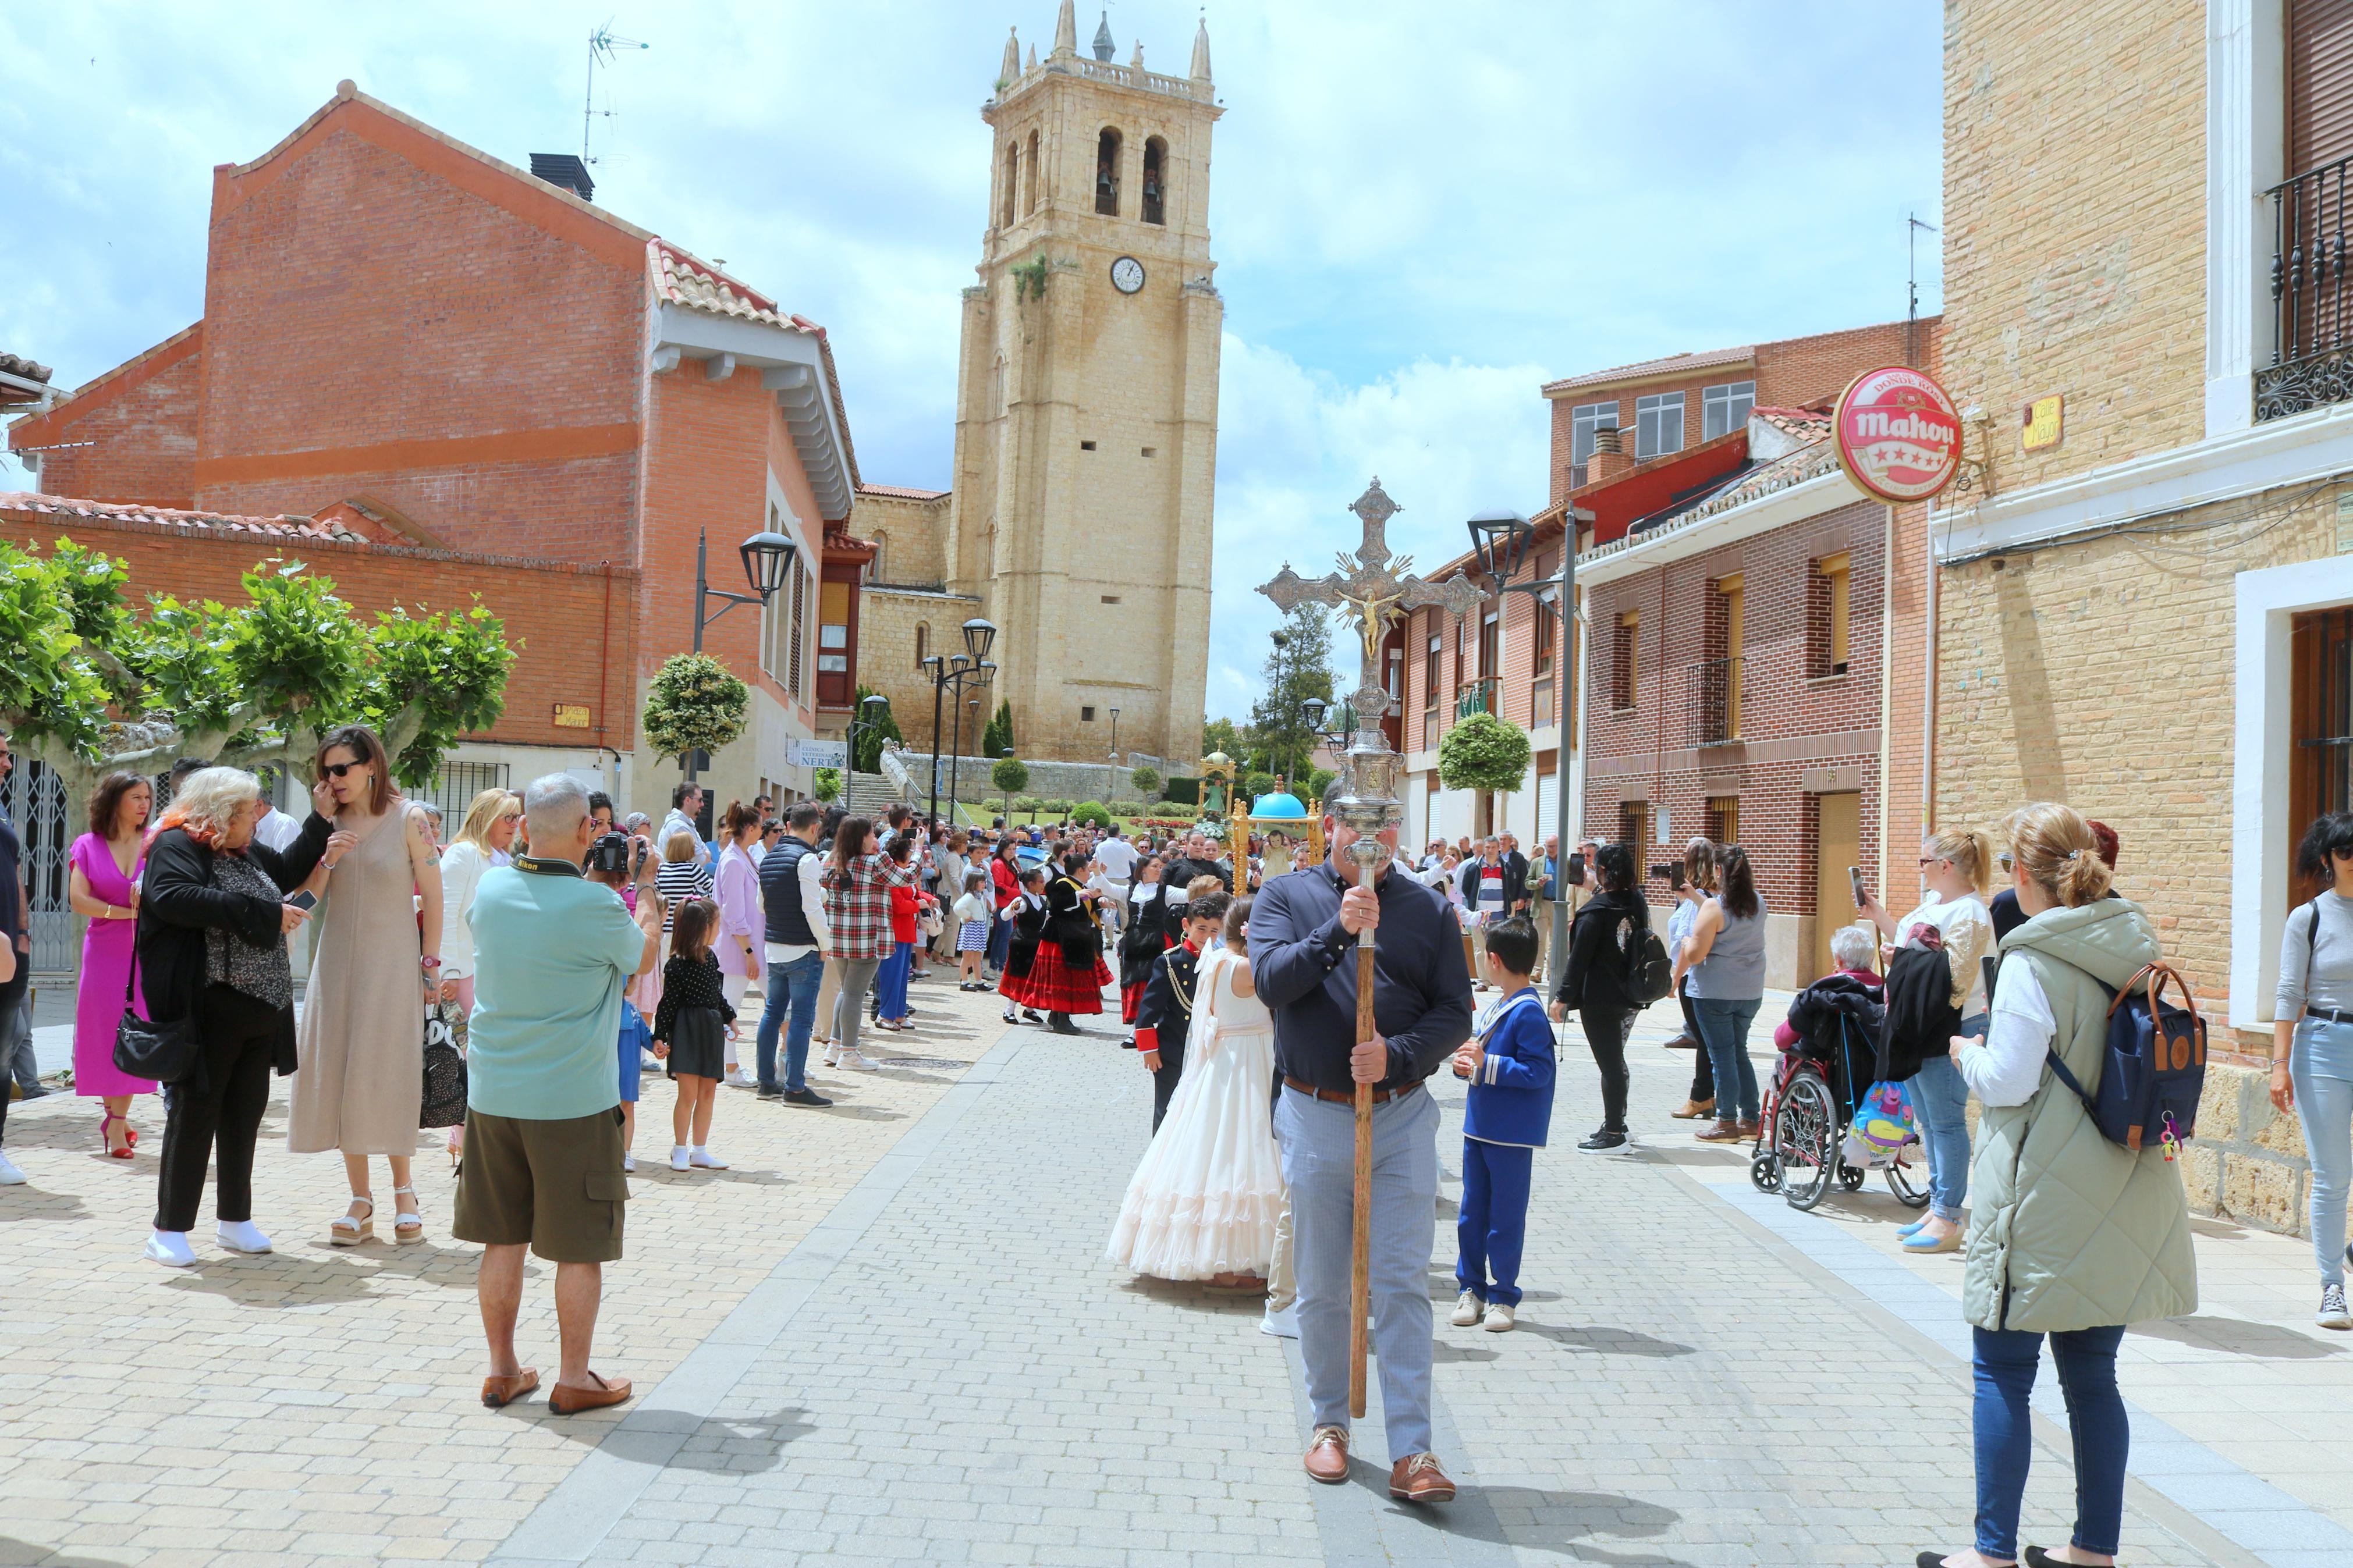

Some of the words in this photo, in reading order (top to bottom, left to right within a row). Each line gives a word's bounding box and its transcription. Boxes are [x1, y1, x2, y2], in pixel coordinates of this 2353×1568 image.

[1874, 376, 1915, 392] DONDE
[1918, 381, 1946, 406] ROSY
[2035, 400, 2054, 419] Calle
[1856, 413, 1955, 445] Mahou
[2032, 420, 2059, 443] Mayor
[1884, 482, 1910, 493] CINCO
[566, 705, 587, 716] Plaza
[517, 859, 538, 871] Nikon
